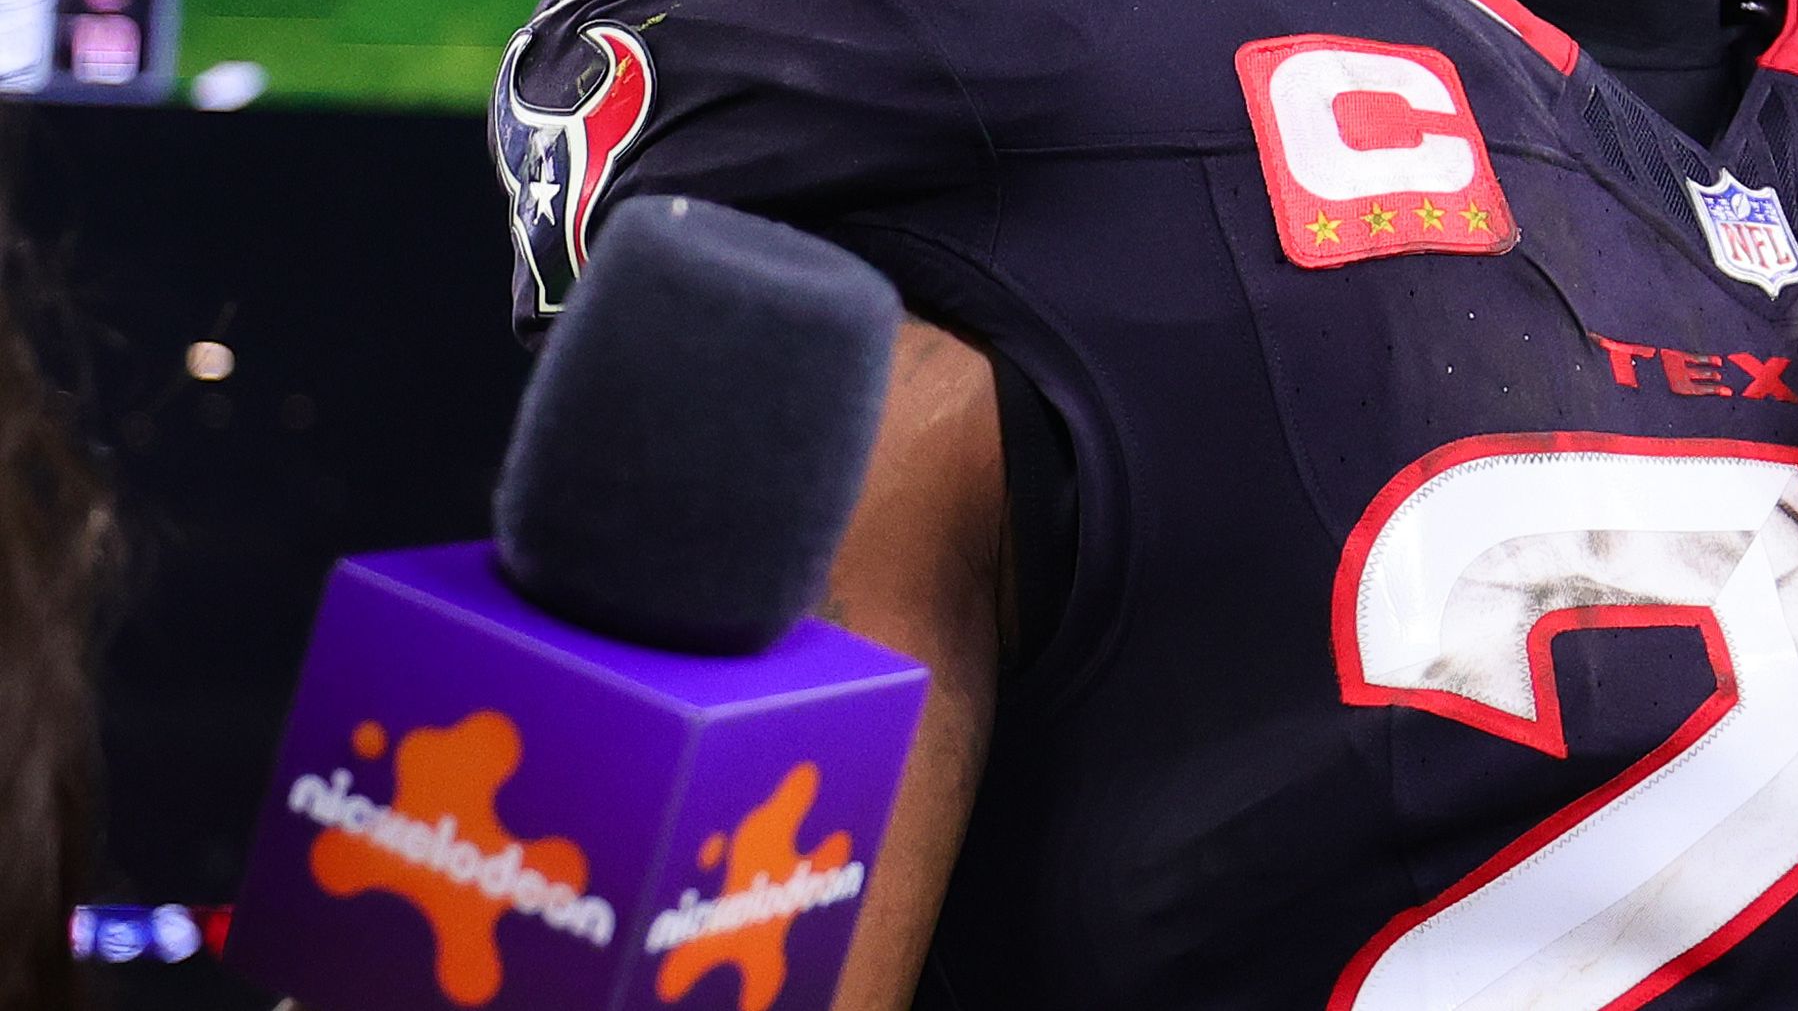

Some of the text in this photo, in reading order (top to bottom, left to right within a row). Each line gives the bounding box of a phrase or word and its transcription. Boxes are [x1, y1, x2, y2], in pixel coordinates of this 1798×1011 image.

[1269, 49, 1474, 201] C
[1719, 221, 1793, 269] NFL
[288, 768, 615, 946] nickelodeon
